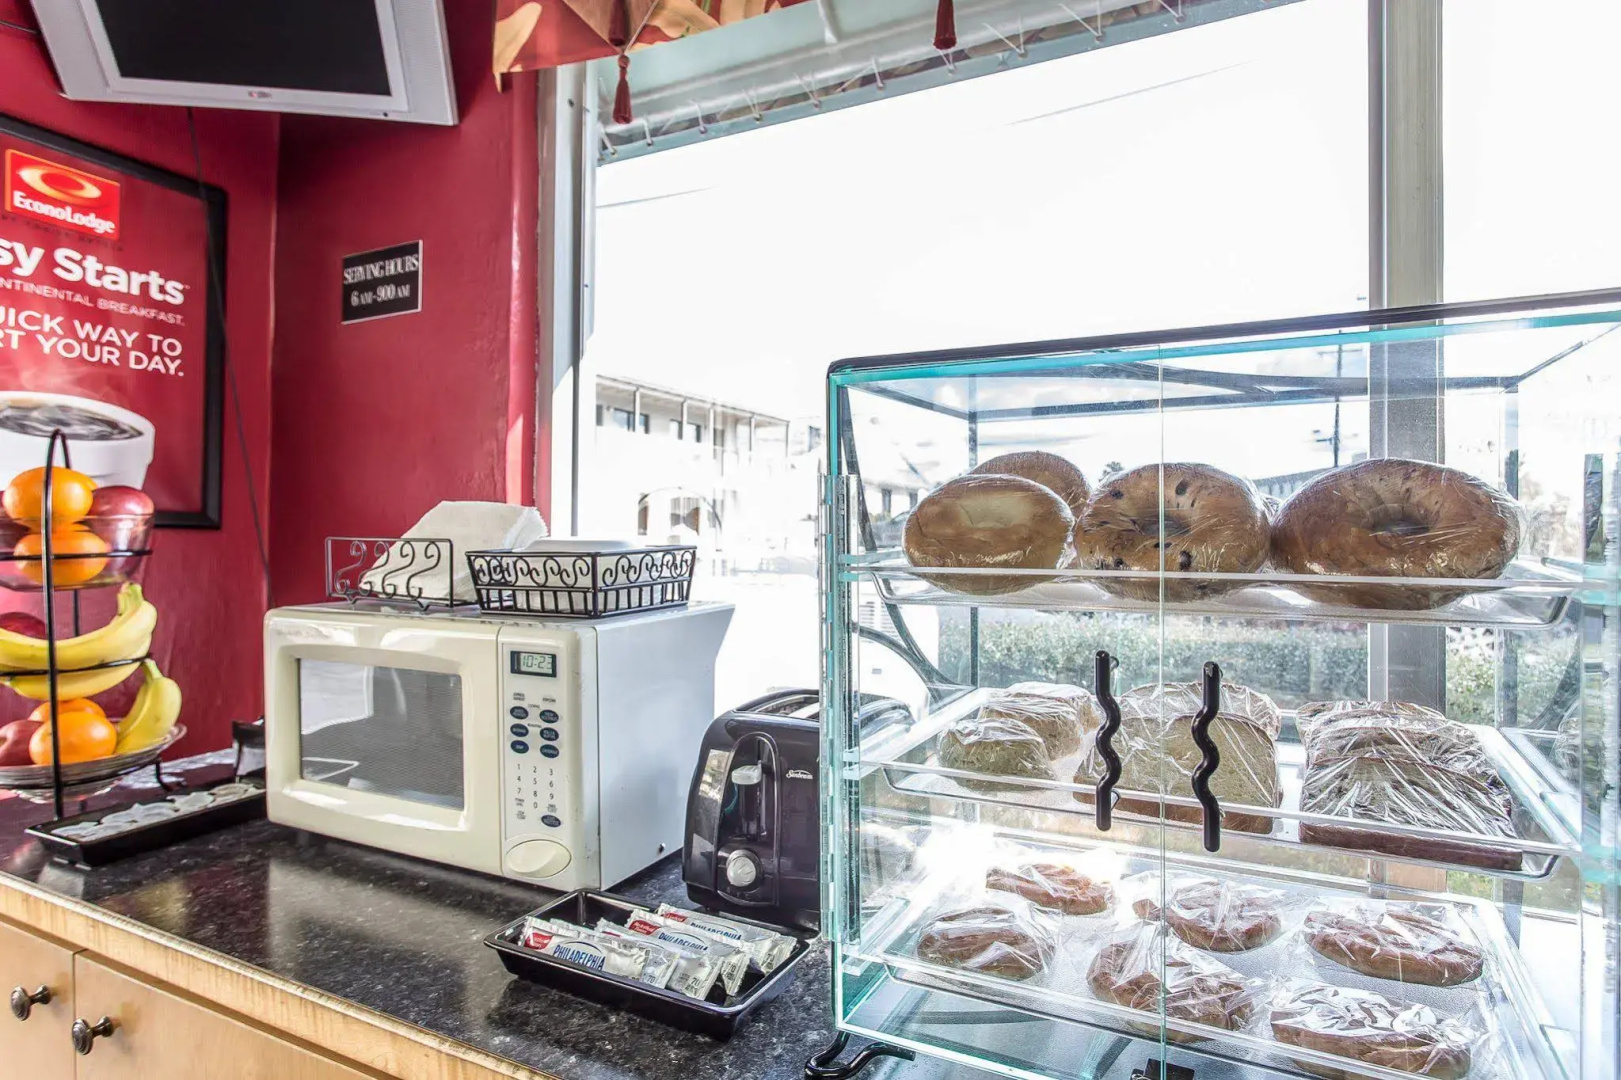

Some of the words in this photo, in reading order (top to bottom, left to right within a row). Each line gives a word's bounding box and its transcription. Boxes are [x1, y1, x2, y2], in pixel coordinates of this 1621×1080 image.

[13, 190, 115, 234] EconoLodge
[53, 247, 185, 305] Starts
[343, 261, 385, 284] SERVING
[385, 253, 419, 276] HOURS
[36, 333, 120, 366] YOUR
[129, 351, 185, 377] DAY.
[73, 319, 140, 349] WAY
[147, 333, 183, 357] TO
[553, 944, 606, 970] PHILADELPHIA
